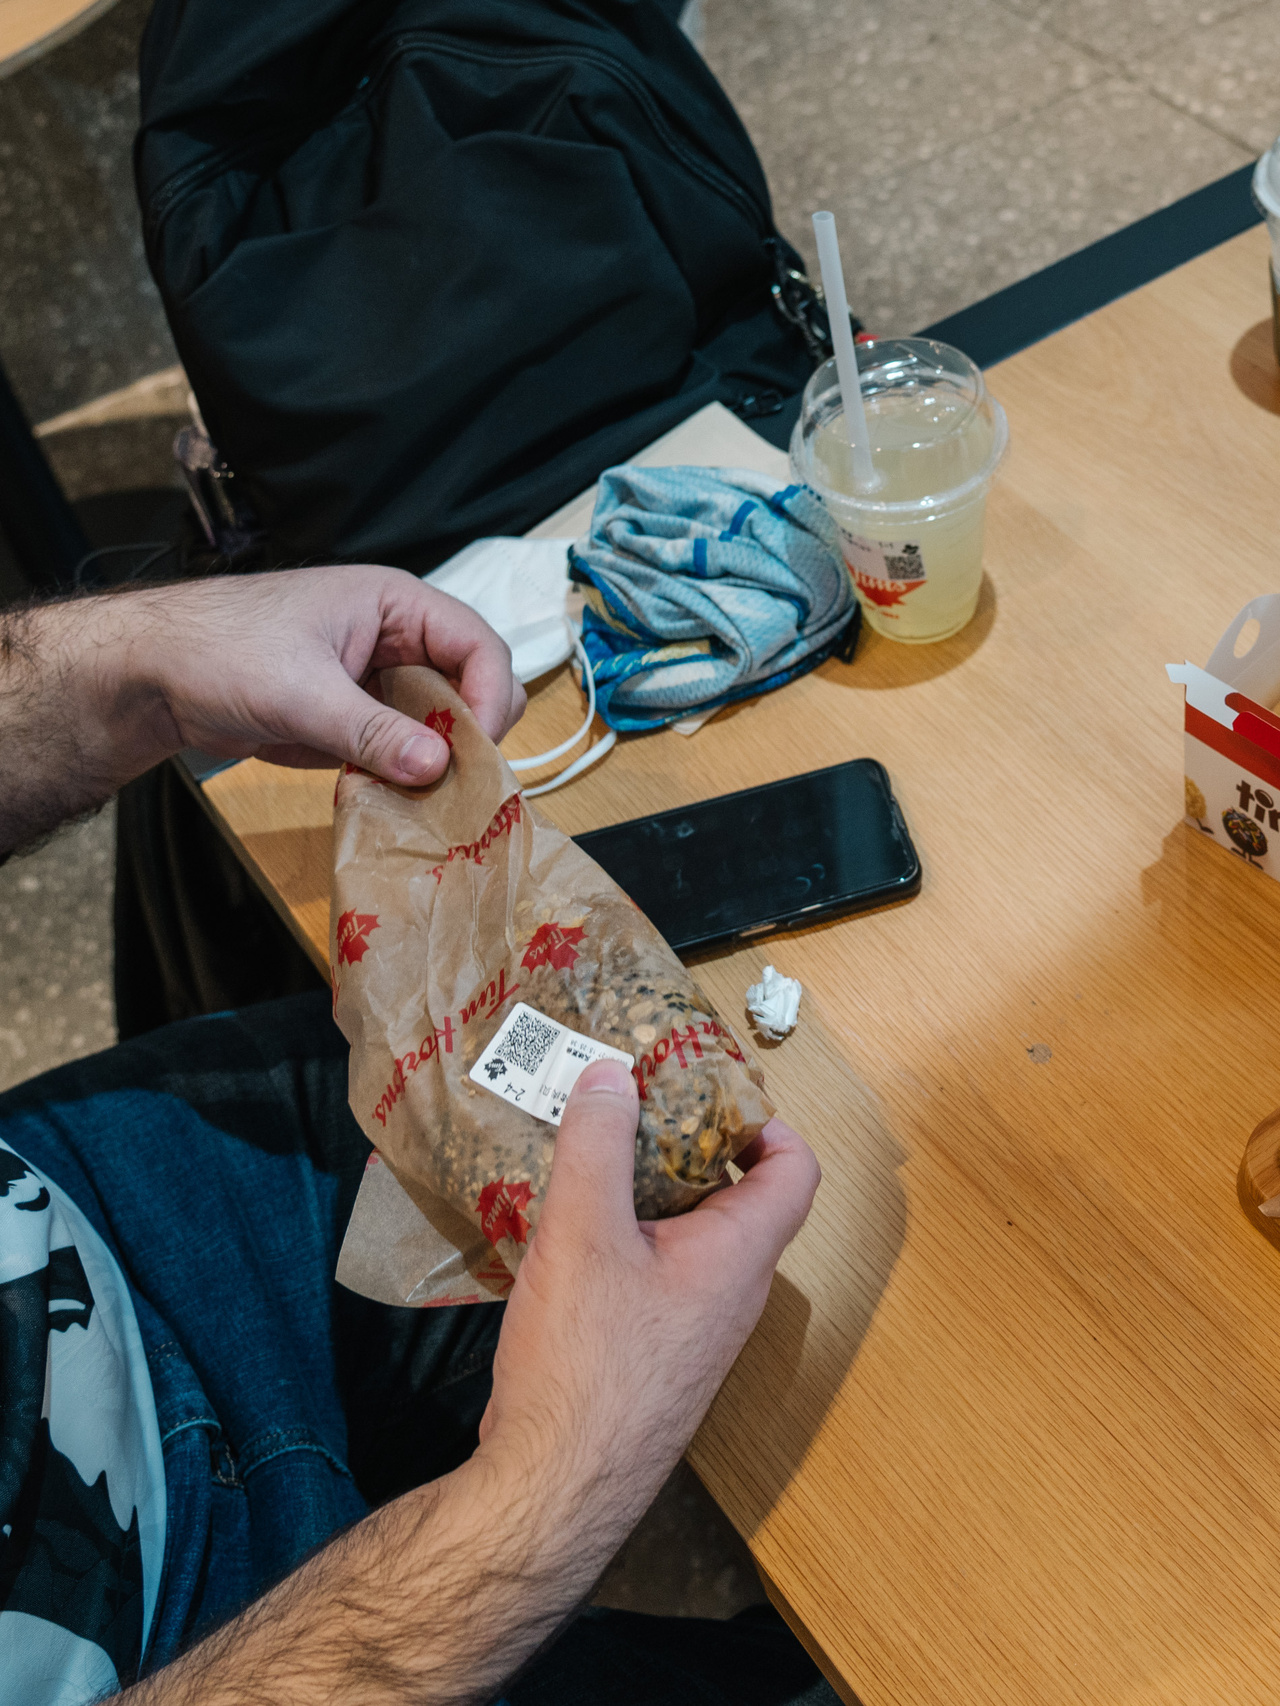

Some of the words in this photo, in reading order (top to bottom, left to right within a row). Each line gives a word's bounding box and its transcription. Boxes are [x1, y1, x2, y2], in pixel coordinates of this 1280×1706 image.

[458, 968, 521, 1024] Tim
[503, 1082, 526, 1102] 2-4
[484, 1186, 520, 1231] Tims
